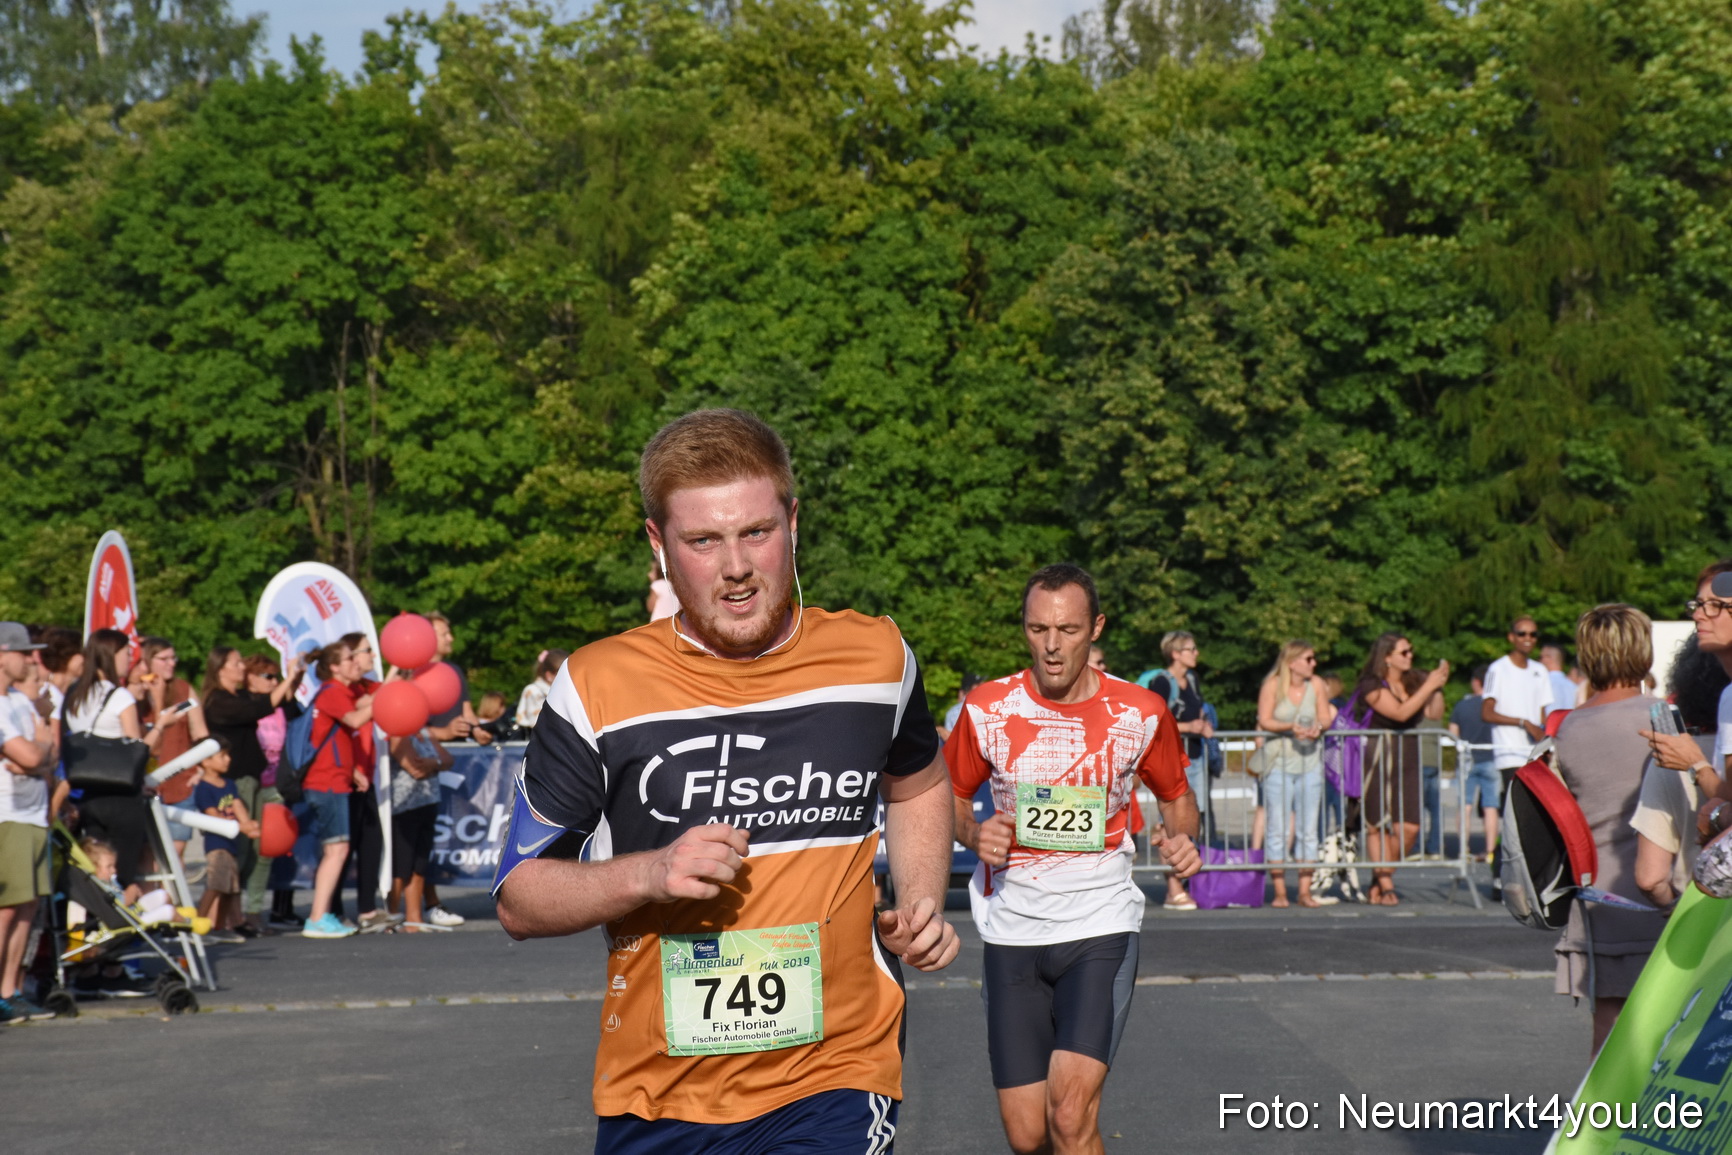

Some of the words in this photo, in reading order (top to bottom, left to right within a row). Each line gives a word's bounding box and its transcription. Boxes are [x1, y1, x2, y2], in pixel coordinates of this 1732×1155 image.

[681, 761, 878, 810] Fischer
[1026, 806, 1093, 832] 2223
[1032, 830, 1054, 838] Pürzer
[1056, 832, 1088, 840] Bernhard
[683, 954, 745, 969] firmenlauf
[782, 956, 811, 969] 2019
[695, 972, 786, 1020] 749
[712, 1022, 731, 1033] Fix
[734, 1019, 777, 1031] Florian
[692, 1034, 720, 1044] Fischer
[724, 1031, 771, 1043] Automobile
[773, 1027, 797, 1037] GmbH
